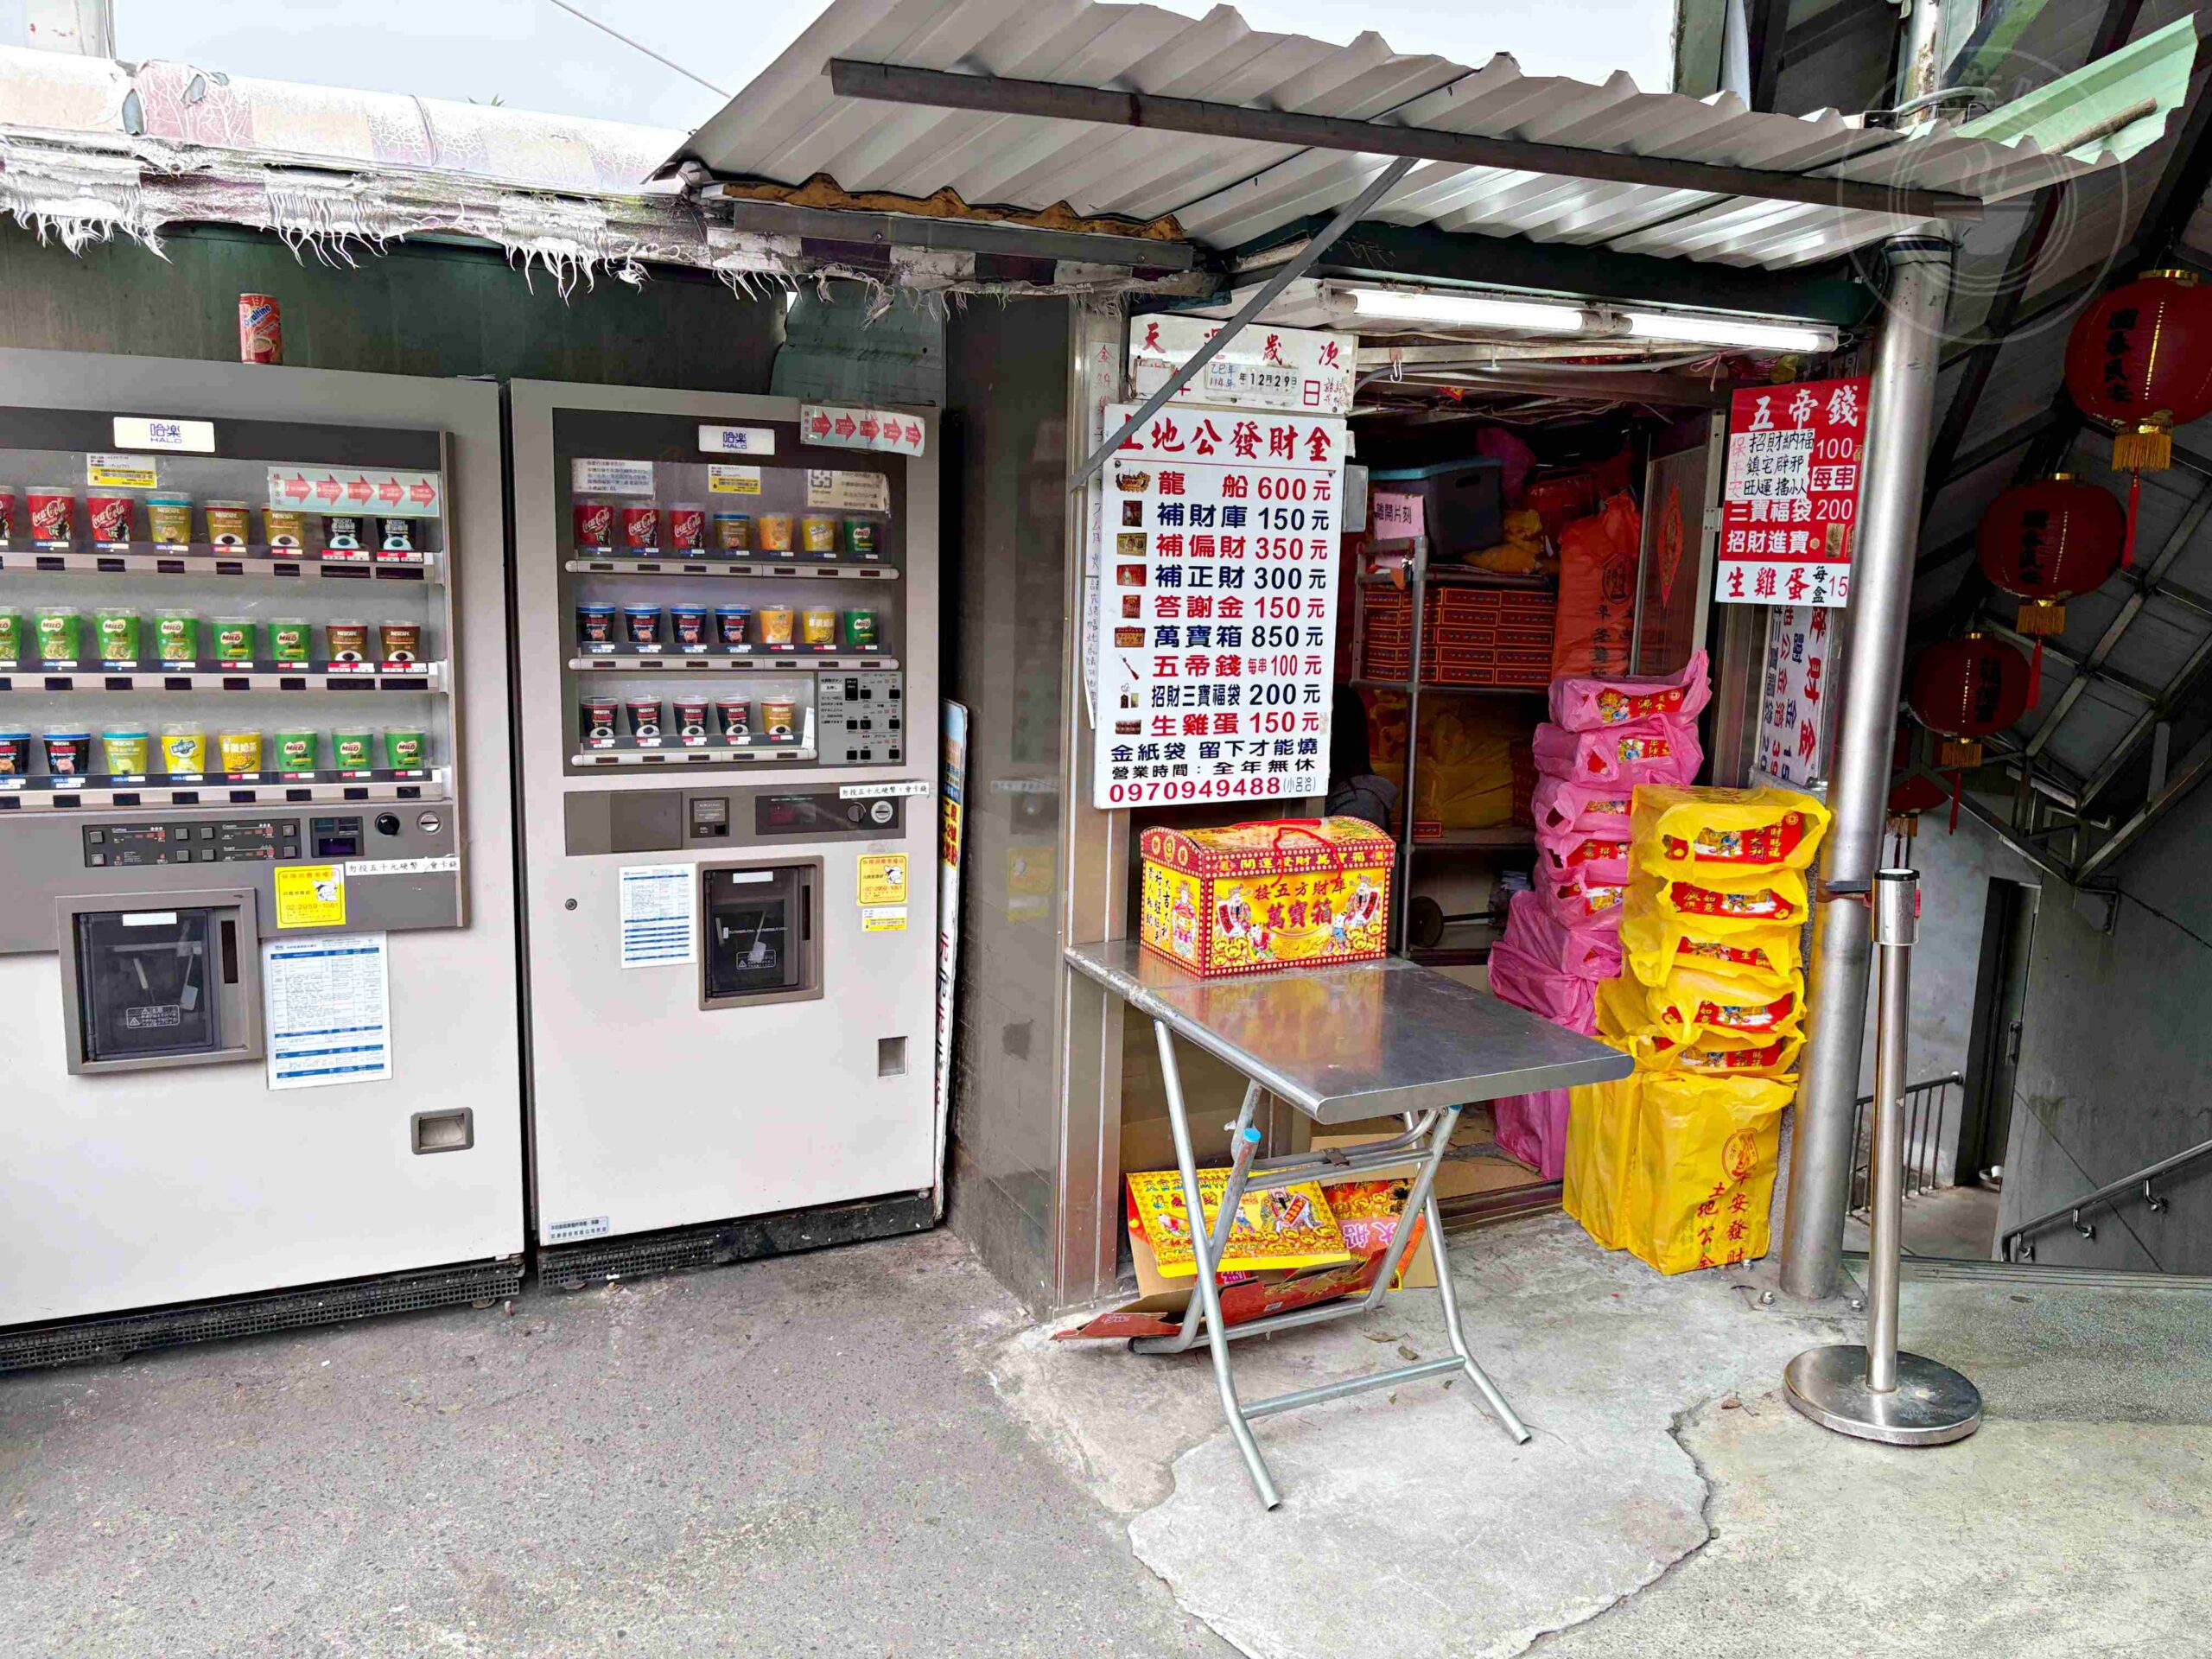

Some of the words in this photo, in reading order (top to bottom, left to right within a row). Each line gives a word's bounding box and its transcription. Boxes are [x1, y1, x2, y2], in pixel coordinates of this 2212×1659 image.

[1748, 385, 1859, 432] 五帝錢
[1749, 429, 1815, 454] 招財納福
[1816, 437, 1853, 460] 100
[1728, 435, 1746, 499] 保平安
[1813, 466, 1853, 490] 每串
[1157, 502, 1247, 528] 補財庫
[1729, 499, 1812, 523] 三寶福袋
[1815, 499, 1853, 521] 200
[1156, 533, 1246, 559] 補偏財
[1727, 530, 1810, 555] 招財進寶
[1154, 565, 1245, 589] 補正財
[1726, 566, 1810, 601] 生雞蛋
[1154, 594, 1244, 619] 答謝金
[1154, 625, 1243, 649] 萬寶箱
[1152, 654, 1242, 678] 五帝錢
[1152, 684, 1241, 708] 招財三寶福袋
[1151, 713, 1239, 737] 生雞蛋
[1110, 742, 1186, 763] 金紙袋
[1198, 738, 1319, 759] 留下才能燒
[1212, 759, 1315, 776] 全年無休
[1109, 777, 1281, 804] 0970949488
[1265, 897, 1333, 931] 萬寶箱
